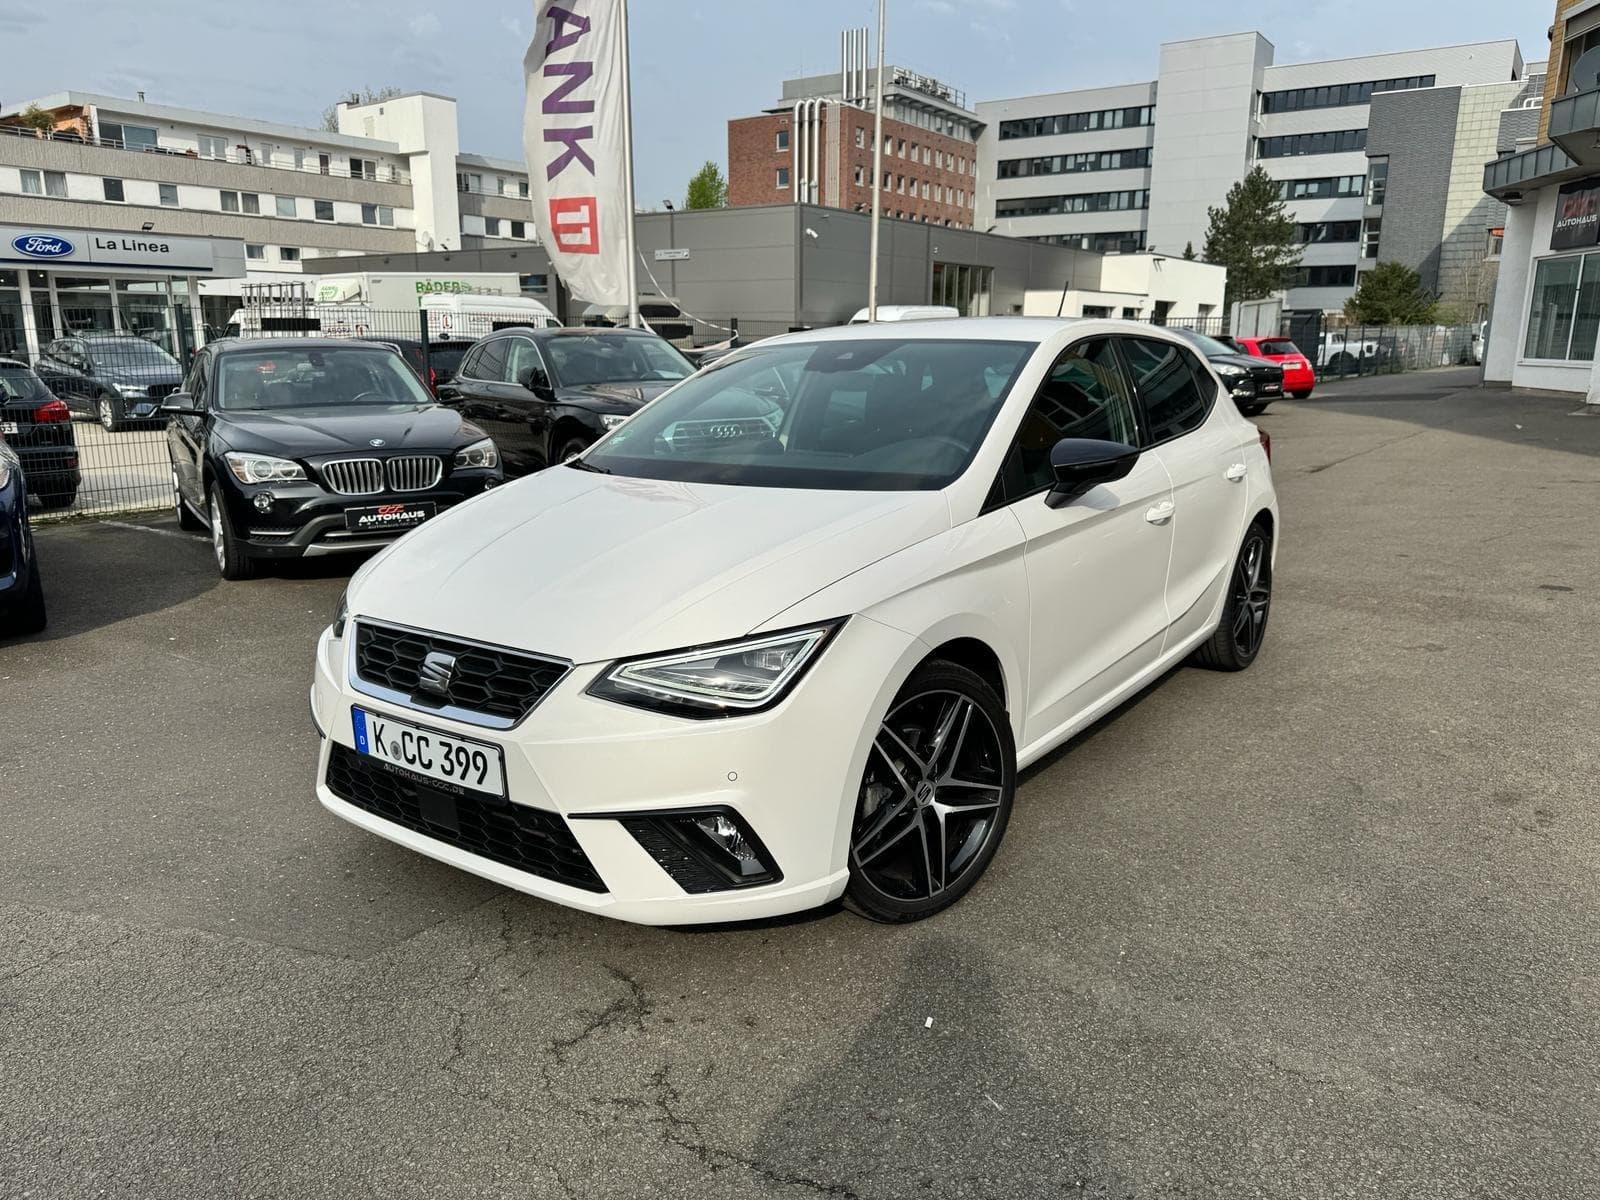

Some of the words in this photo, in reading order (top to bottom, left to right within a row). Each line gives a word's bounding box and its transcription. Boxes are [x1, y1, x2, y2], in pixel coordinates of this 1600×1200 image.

[542, 6, 595, 182] ANK
[1556, 214, 1597, 228] AUTOHAUS
[25, 236, 62, 253] Ford
[95, 237, 117, 250] La
[122, 238, 170, 253] Linea
[359, 511, 425, 522] AUTOHAUS
[372, 721, 388, 756] K
[401, 731, 432, 770] CC
[439, 741, 488, 785] 399
